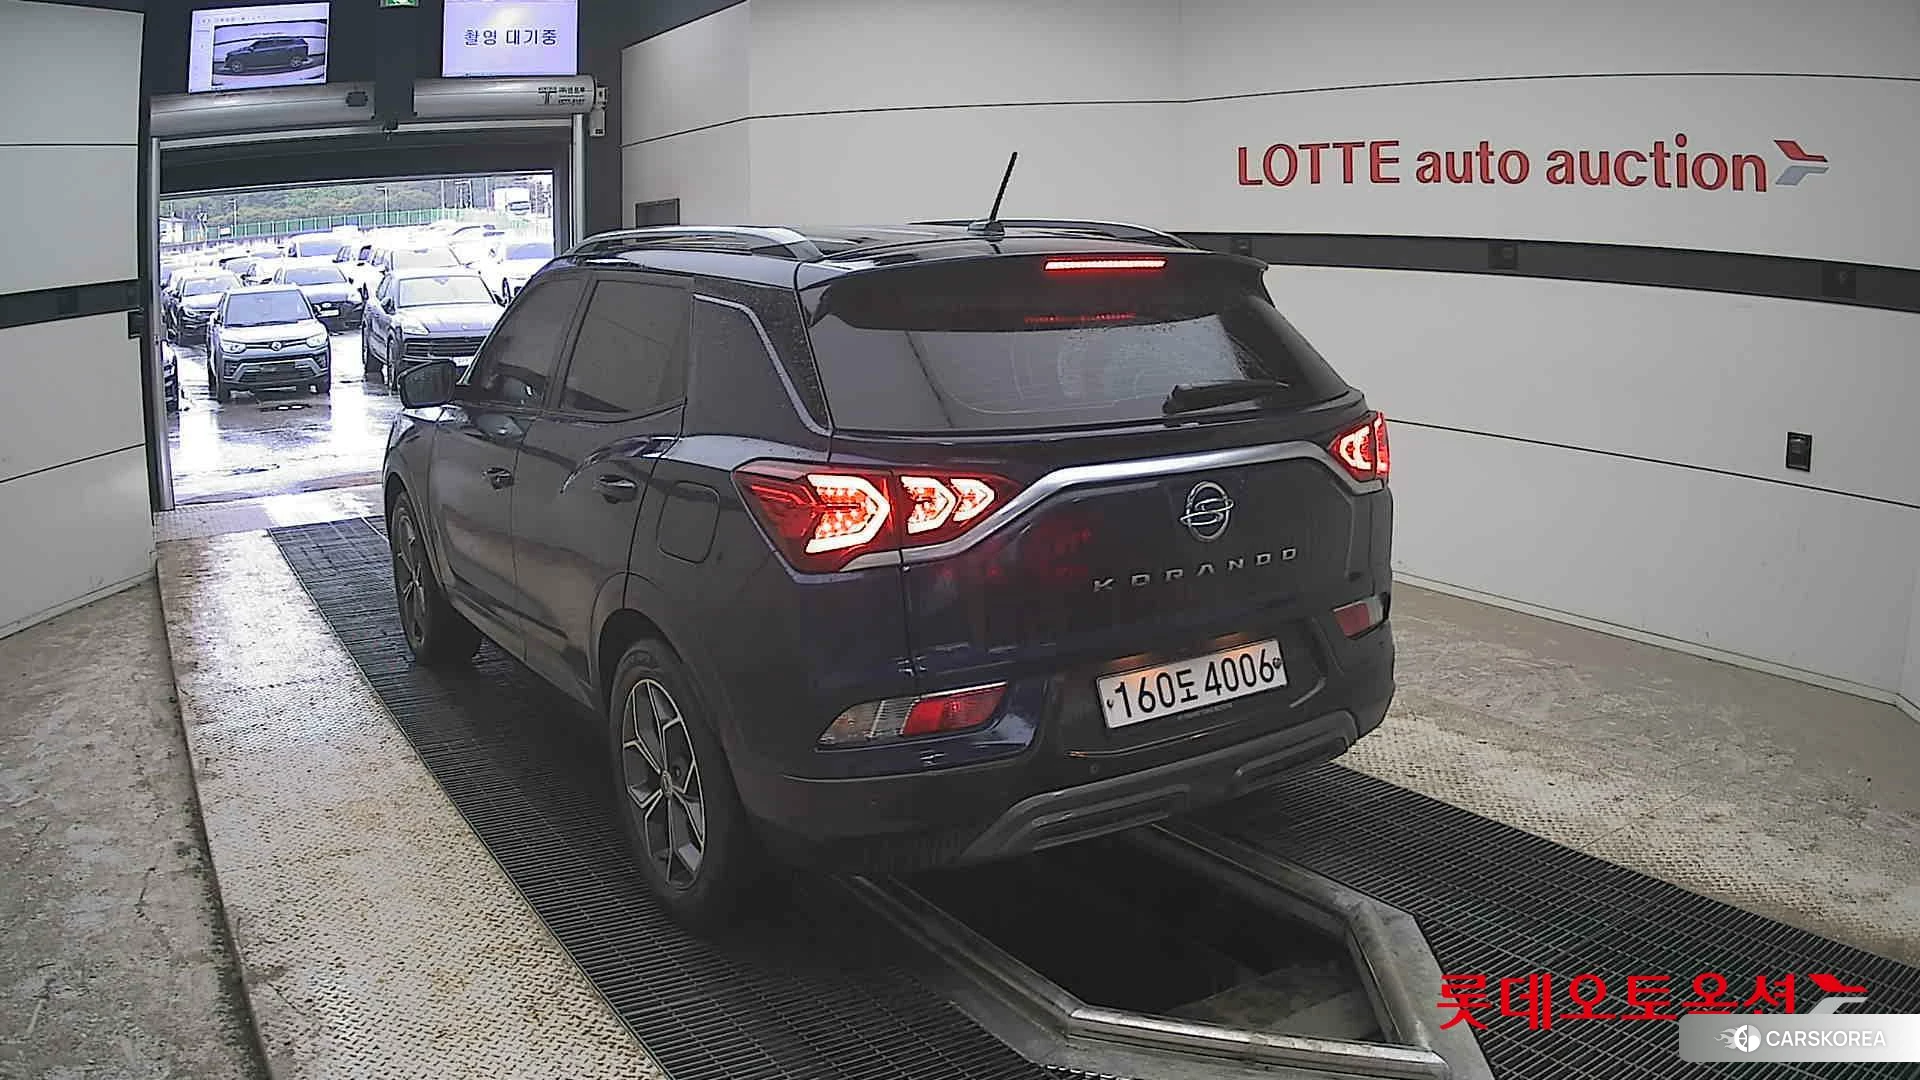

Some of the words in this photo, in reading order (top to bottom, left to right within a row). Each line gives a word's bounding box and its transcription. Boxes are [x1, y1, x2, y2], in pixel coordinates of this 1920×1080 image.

[464, 29, 497, 46] 촬영
[506, 29, 557, 46] 대기중
[1238, 140, 1400, 187] LOTTE
[1416, 141, 1530, 186] auto
[1546, 133, 1768, 193] auction
[1092, 547, 1298, 592] KORANDO
[1204, 647, 1276, 697] 4006
